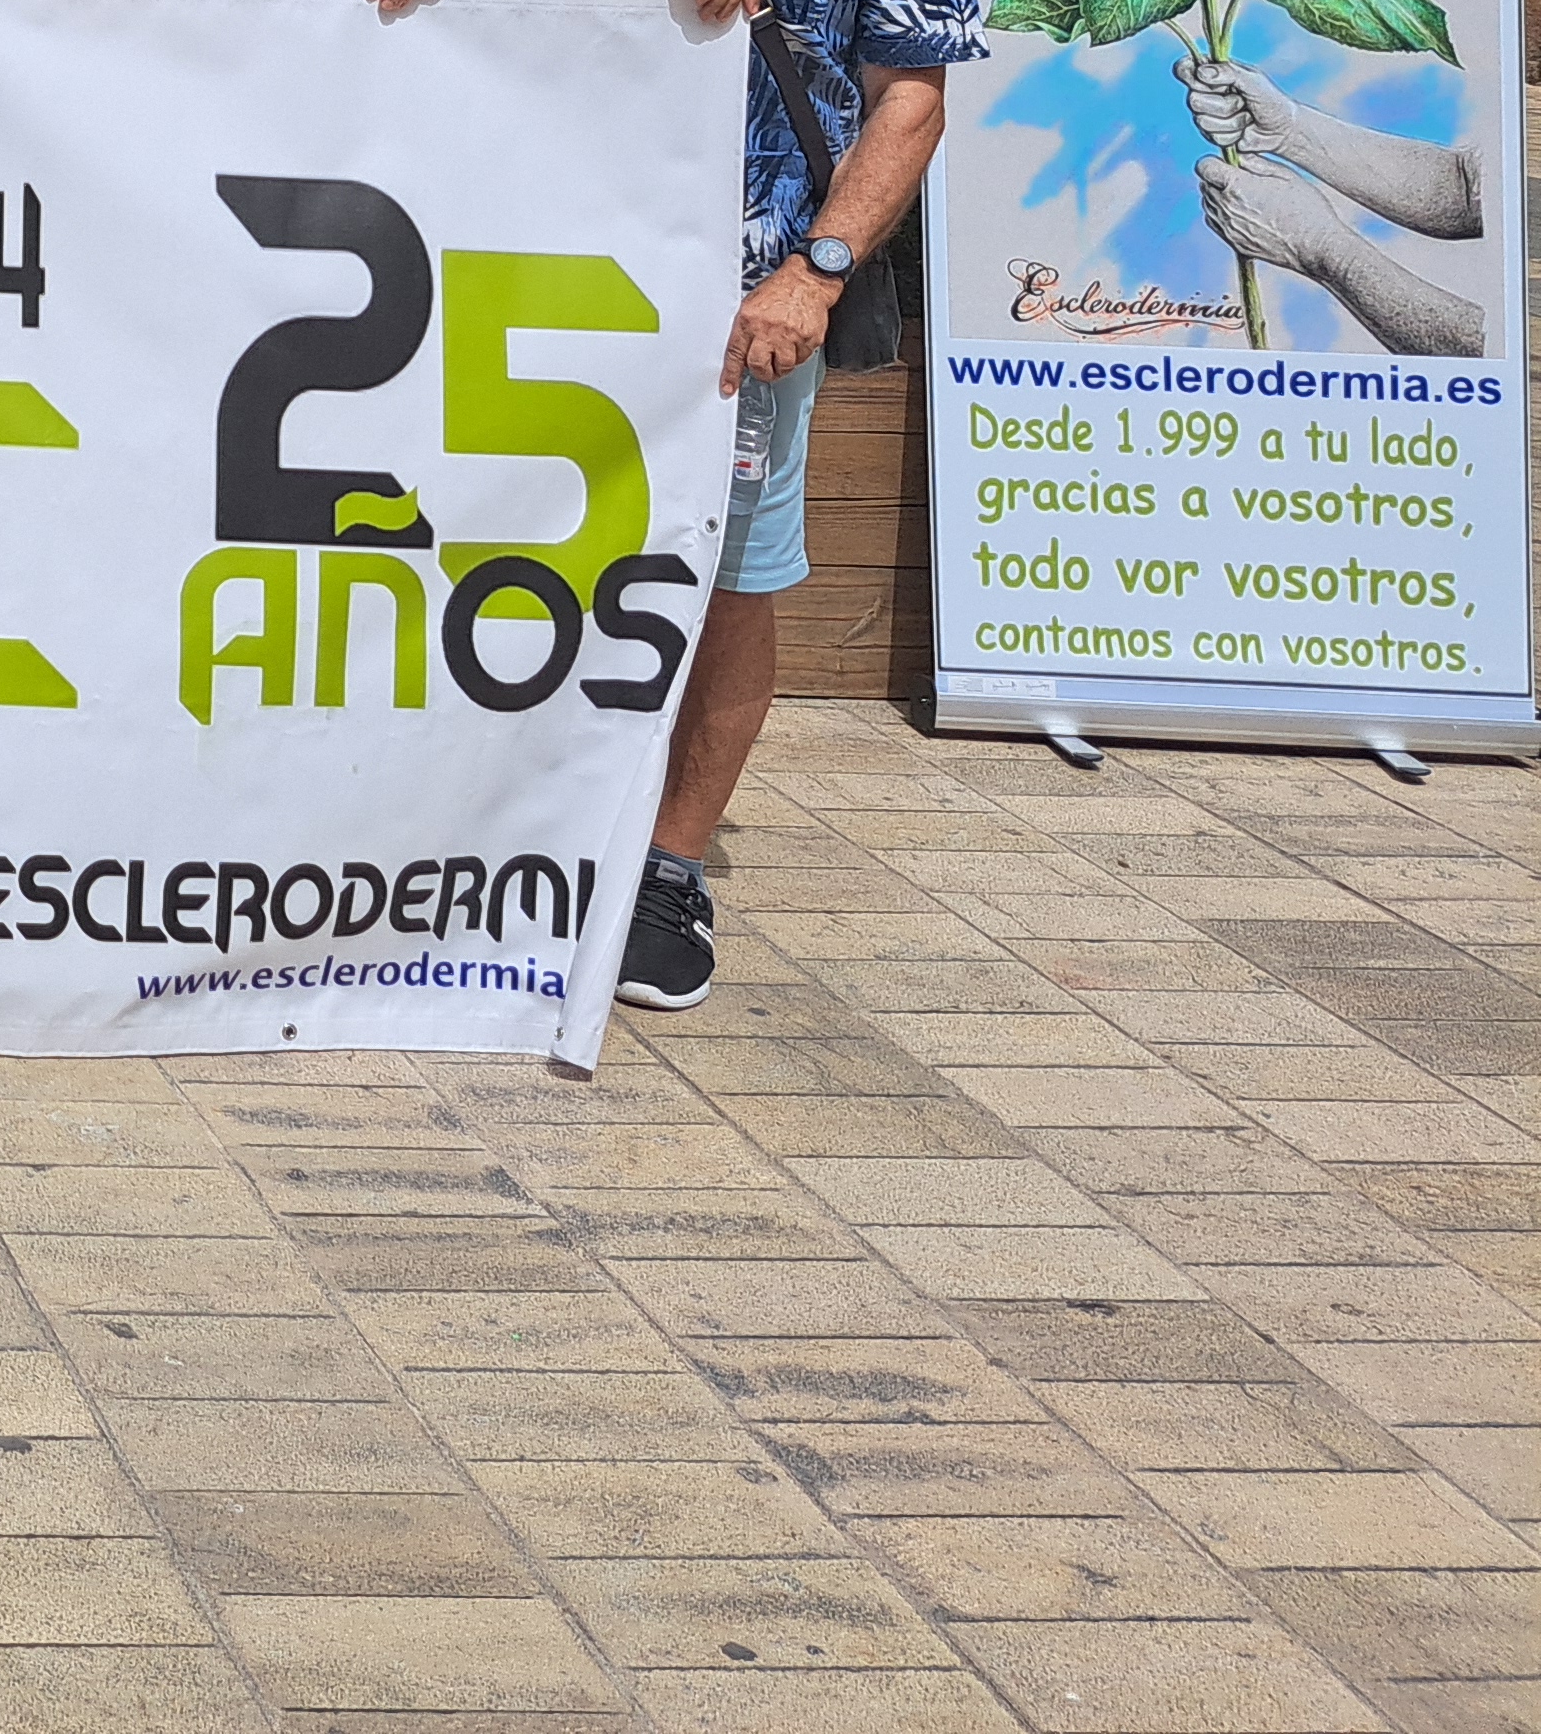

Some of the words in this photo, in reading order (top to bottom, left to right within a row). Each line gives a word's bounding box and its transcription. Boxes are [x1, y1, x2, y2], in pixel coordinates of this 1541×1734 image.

[1007, 257, 1247, 336] Esclerodermia
[214, 172, 661, 623] 25
[947, 355, 1504, 406] www.esclerodermia.es
[969, 402, 1095, 454] Desde
[1116, 408, 1240, 459] 1.999
[1259, 427, 1286, 462] a
[1303, 420, 1349, 464] tu
[1370, 415, 1475, 479] lado,
[976, 469, 1157, 525] gracias
[1180, 484, 1210, 520] a
[1232, 481, 1475, 539] vosotros,
[178, 484, 701, 729] AÑOS
[971, 536, 1092, 593] todo
[1116, 557, 1201, 598] vor
[1224, 556, 1477, 620] vosotros,
[974, 615, 1174, 661] contamos
[1192, 628, 1264, 666] con
[1281, 628, 1484, 677] vosotros.
[136, 950, 568, 1002] www.esclerodermia
